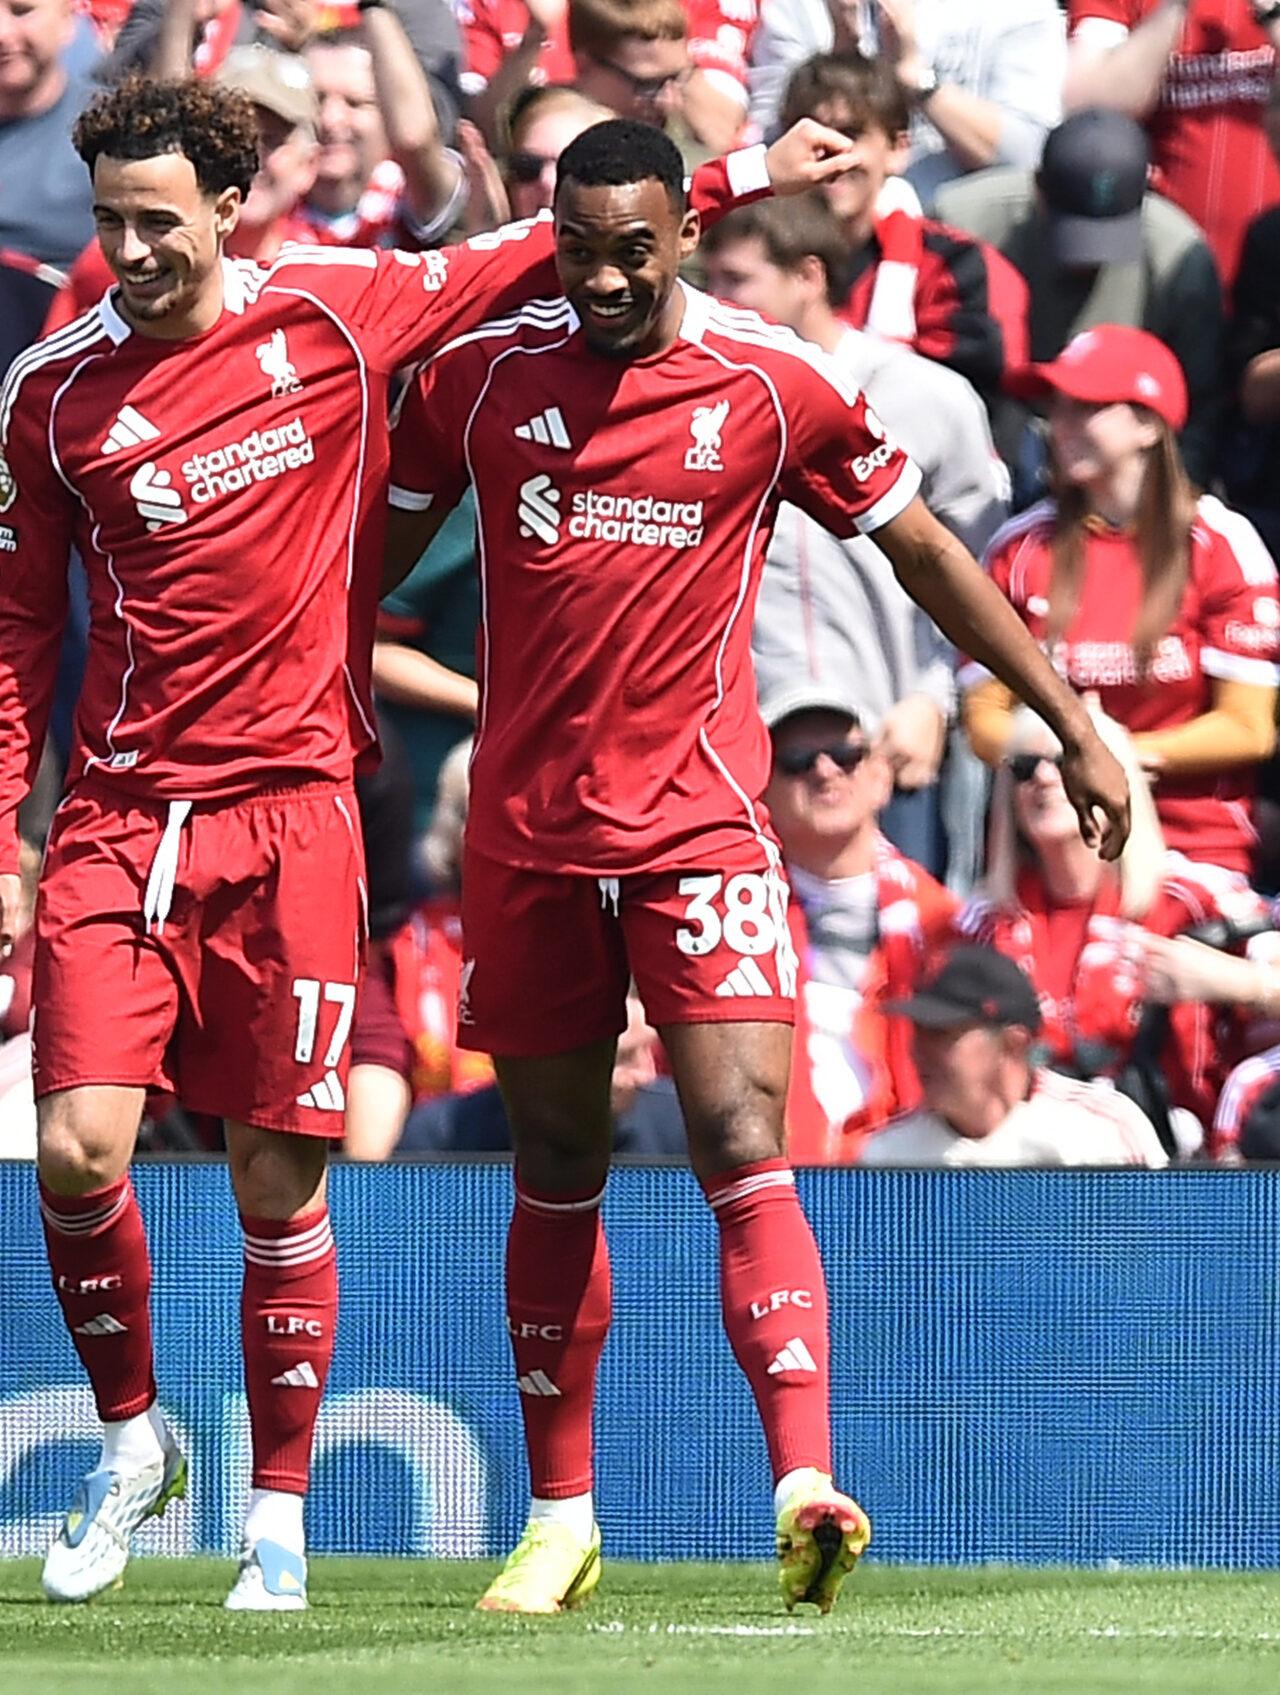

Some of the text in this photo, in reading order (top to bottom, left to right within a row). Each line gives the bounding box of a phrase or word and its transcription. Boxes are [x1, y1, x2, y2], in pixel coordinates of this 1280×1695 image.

[181, 415, 307, 483] standard
[190, 436, 315, 503] chartered
[568, 513, 705, 549] chartered
[571, 489, 704, 526] standard
[676, 872, 777, 956] 38
[293, 979, 356, 1068] 17
[267, 1315, 323, 1337] LFC
[751, 1289, 813, 1320] LFC
